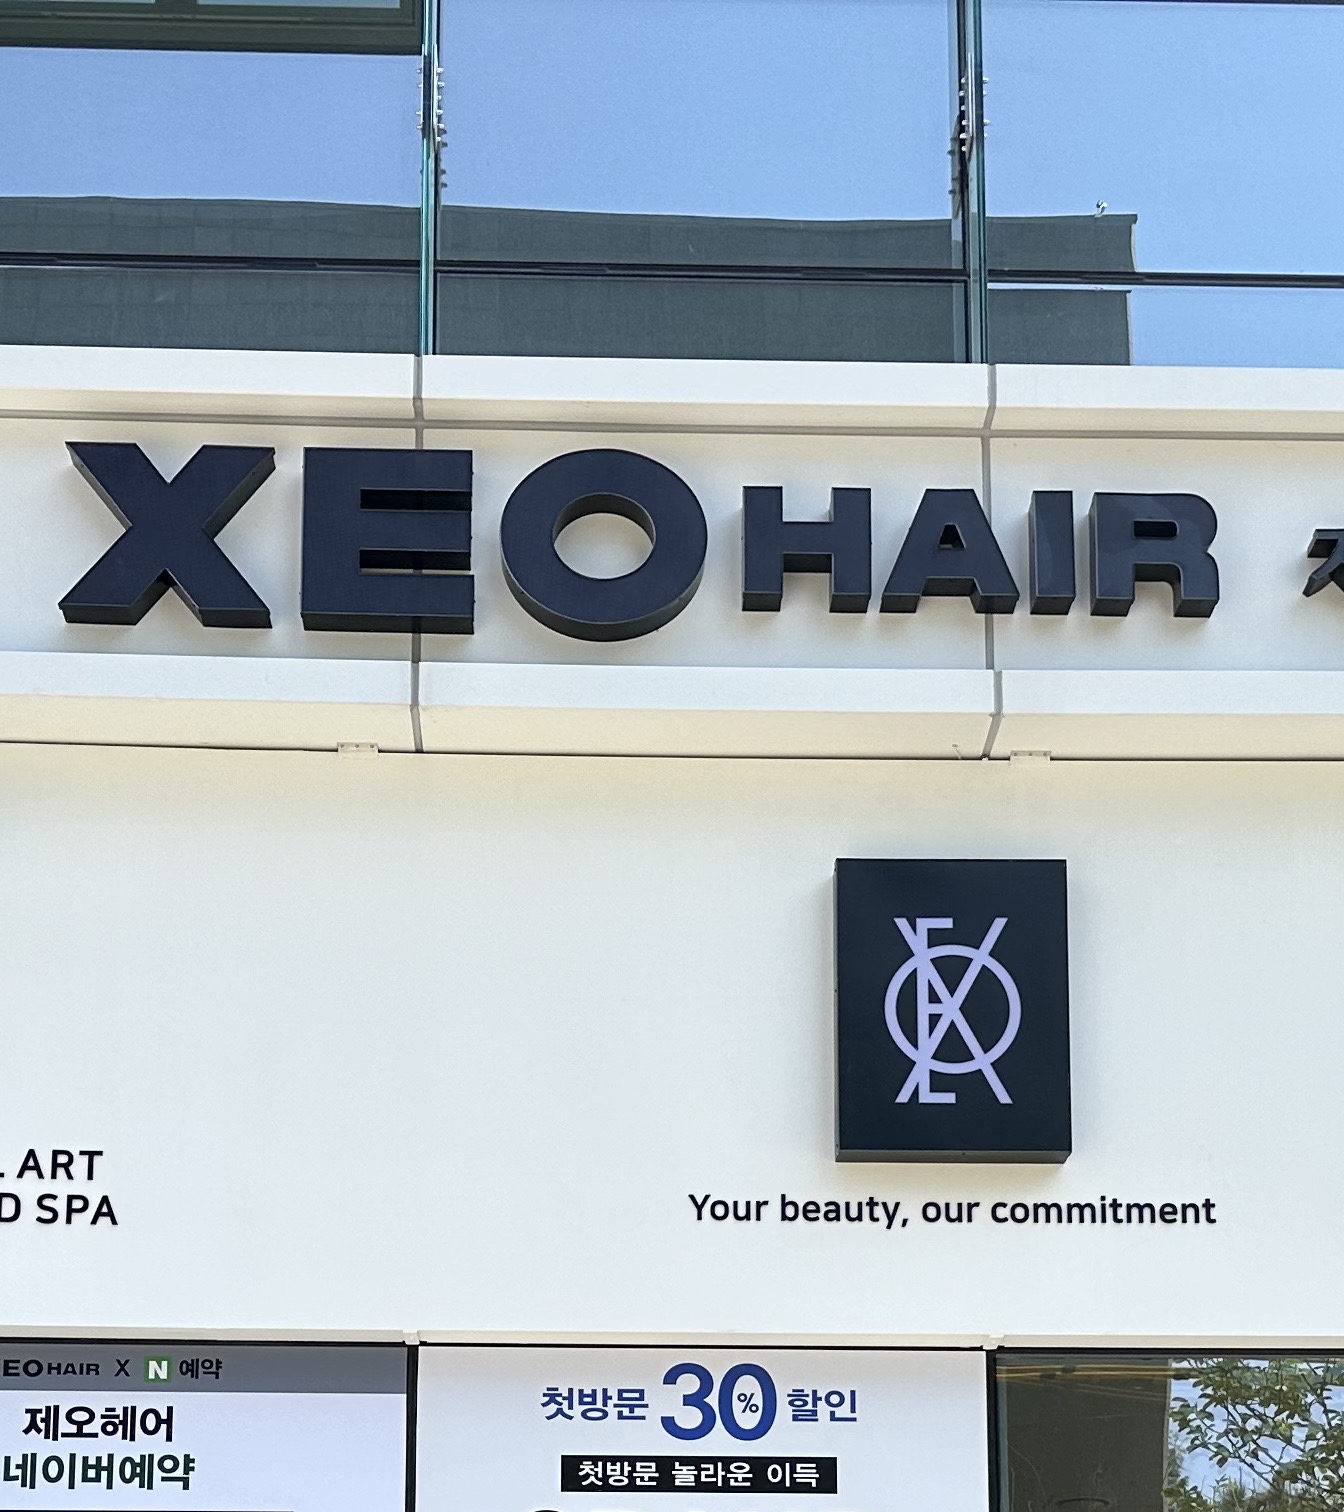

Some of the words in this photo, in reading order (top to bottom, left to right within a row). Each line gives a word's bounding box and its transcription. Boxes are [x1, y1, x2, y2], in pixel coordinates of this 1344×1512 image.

[16, 1148, 105, 1182] ART
[35, 1193, 119, 1227] SPA
[688, 1193, 769, 1223] Your
[780, 1194, 910, 1230] beauty,
[921, 1199, 981, 1225] our
[990, 1196, 1217, 1225] commitment
[149, 1360, 169, 1380] N
[178, 1357, 224, 1381] 예약
[540, 1386, 650, 1423] 첫방문
[786, 1388, 858, 1423] 할인
[21, 1404, 175, 1443] 제오헤어
[2, 1453, 196, 1491] 네이버예약
[578, 1460, 660, 1487] 첫방문
[670, 1461, 754, 1488] 놀라운
[766, 1462, 821, 1488] 이득
